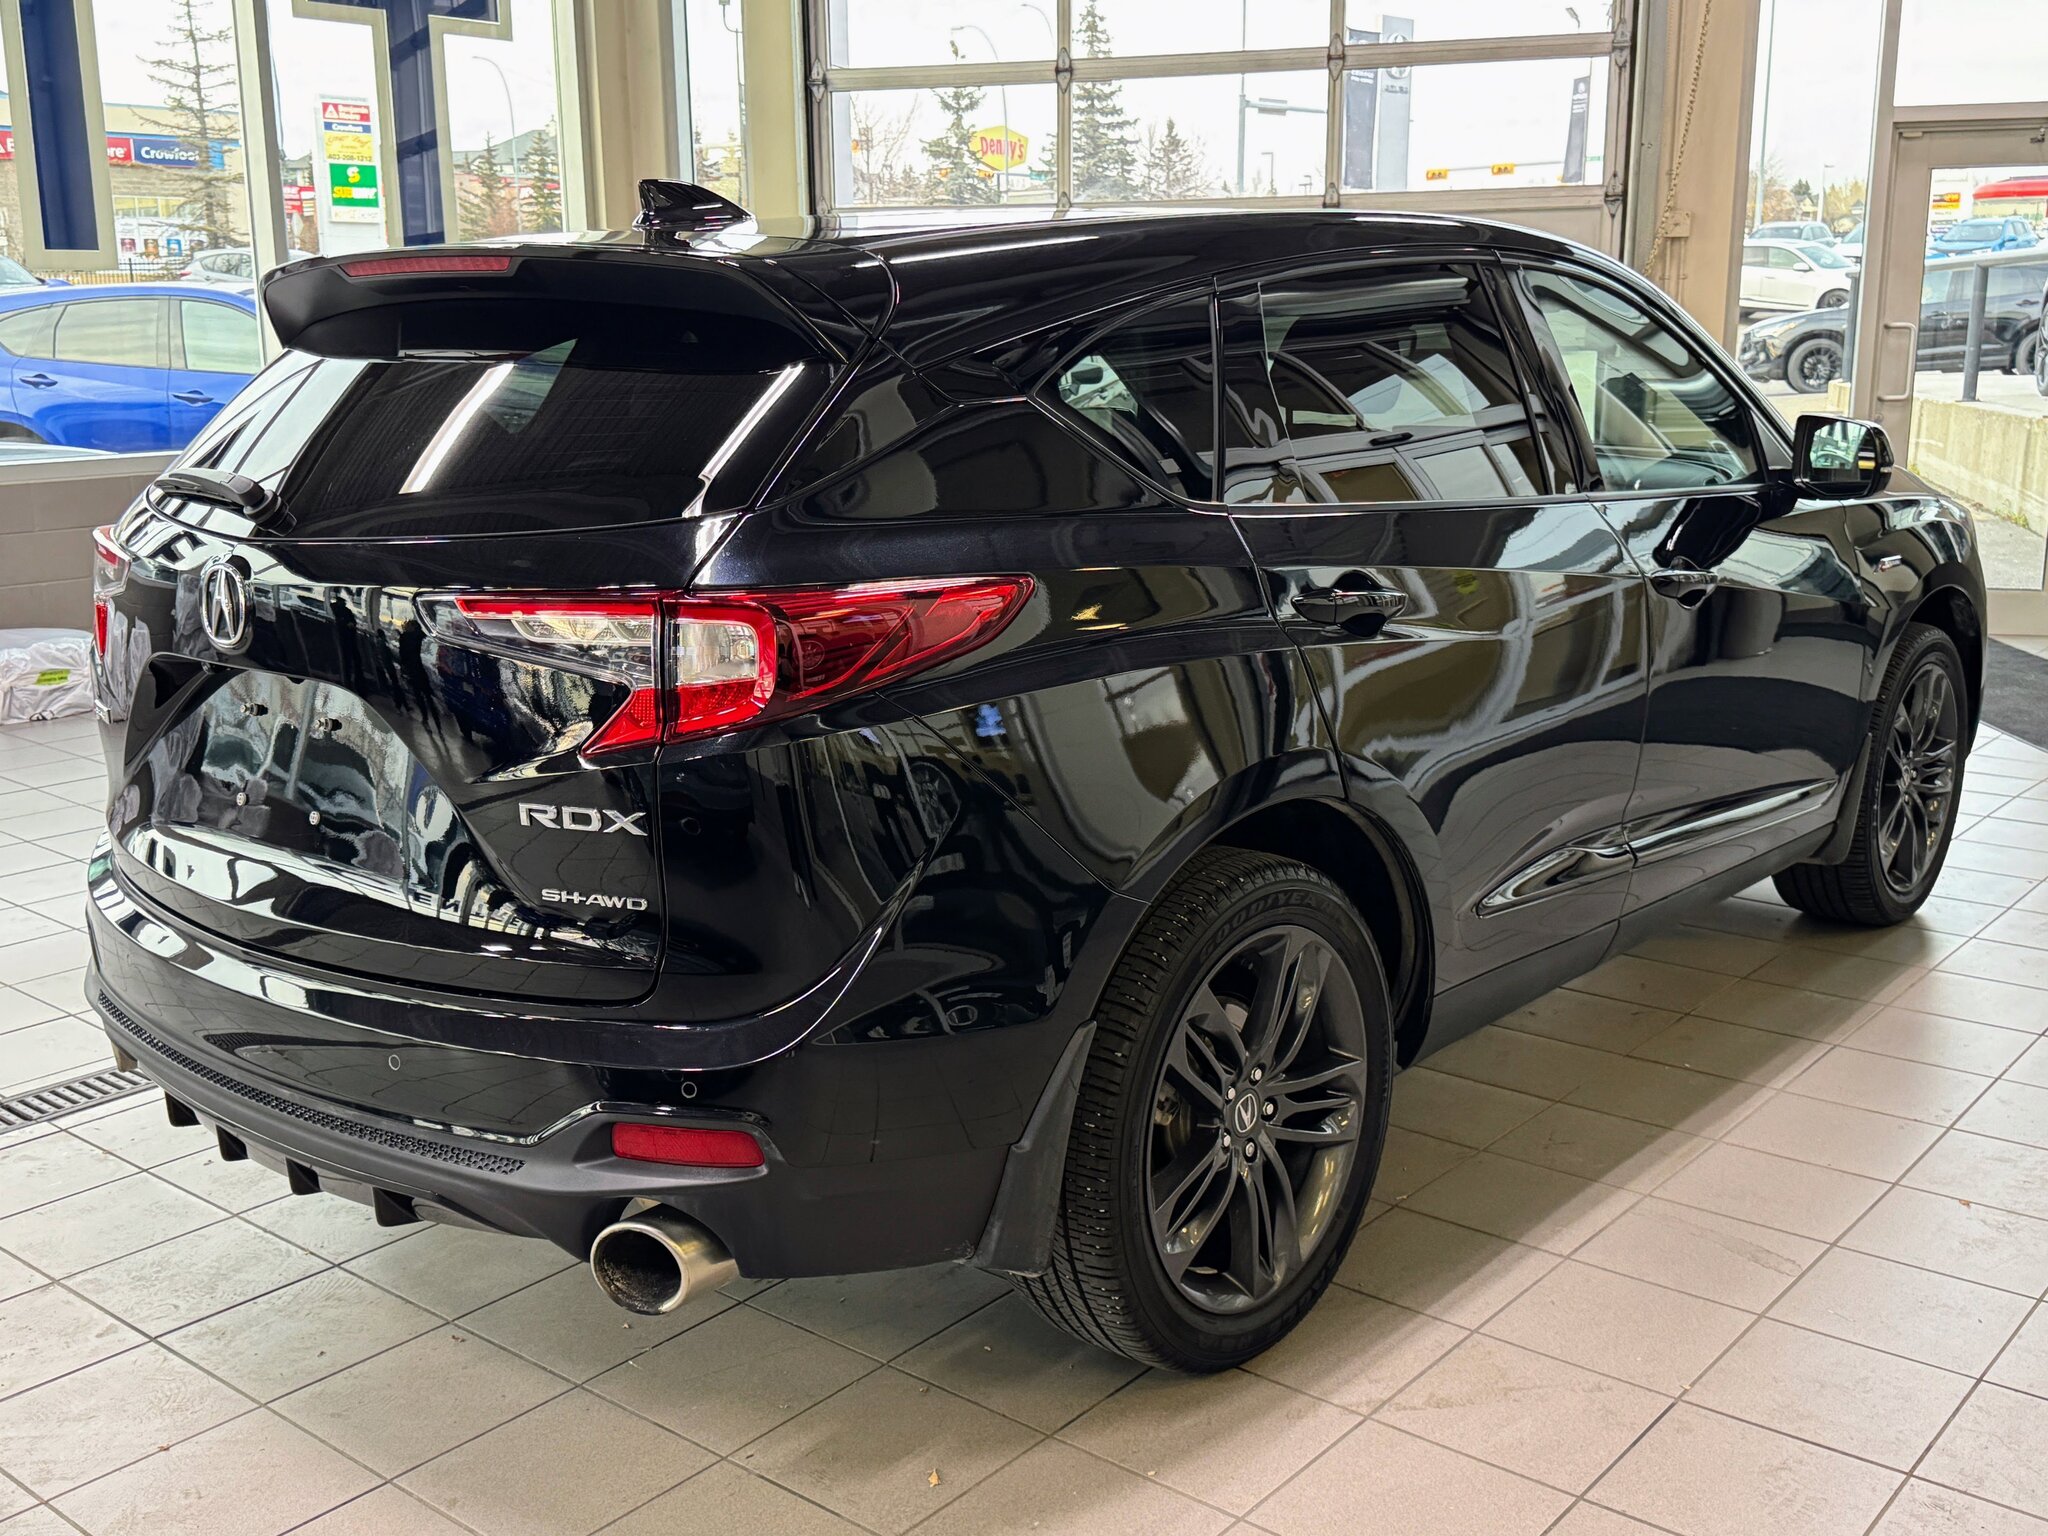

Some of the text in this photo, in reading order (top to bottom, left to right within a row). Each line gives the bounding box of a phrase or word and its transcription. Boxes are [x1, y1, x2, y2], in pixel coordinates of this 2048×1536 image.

[980, 136, 1024, 161] Denny's
[519, 802, 648, 836] RDX
[541, 888, 648, 911] SH-AWD
